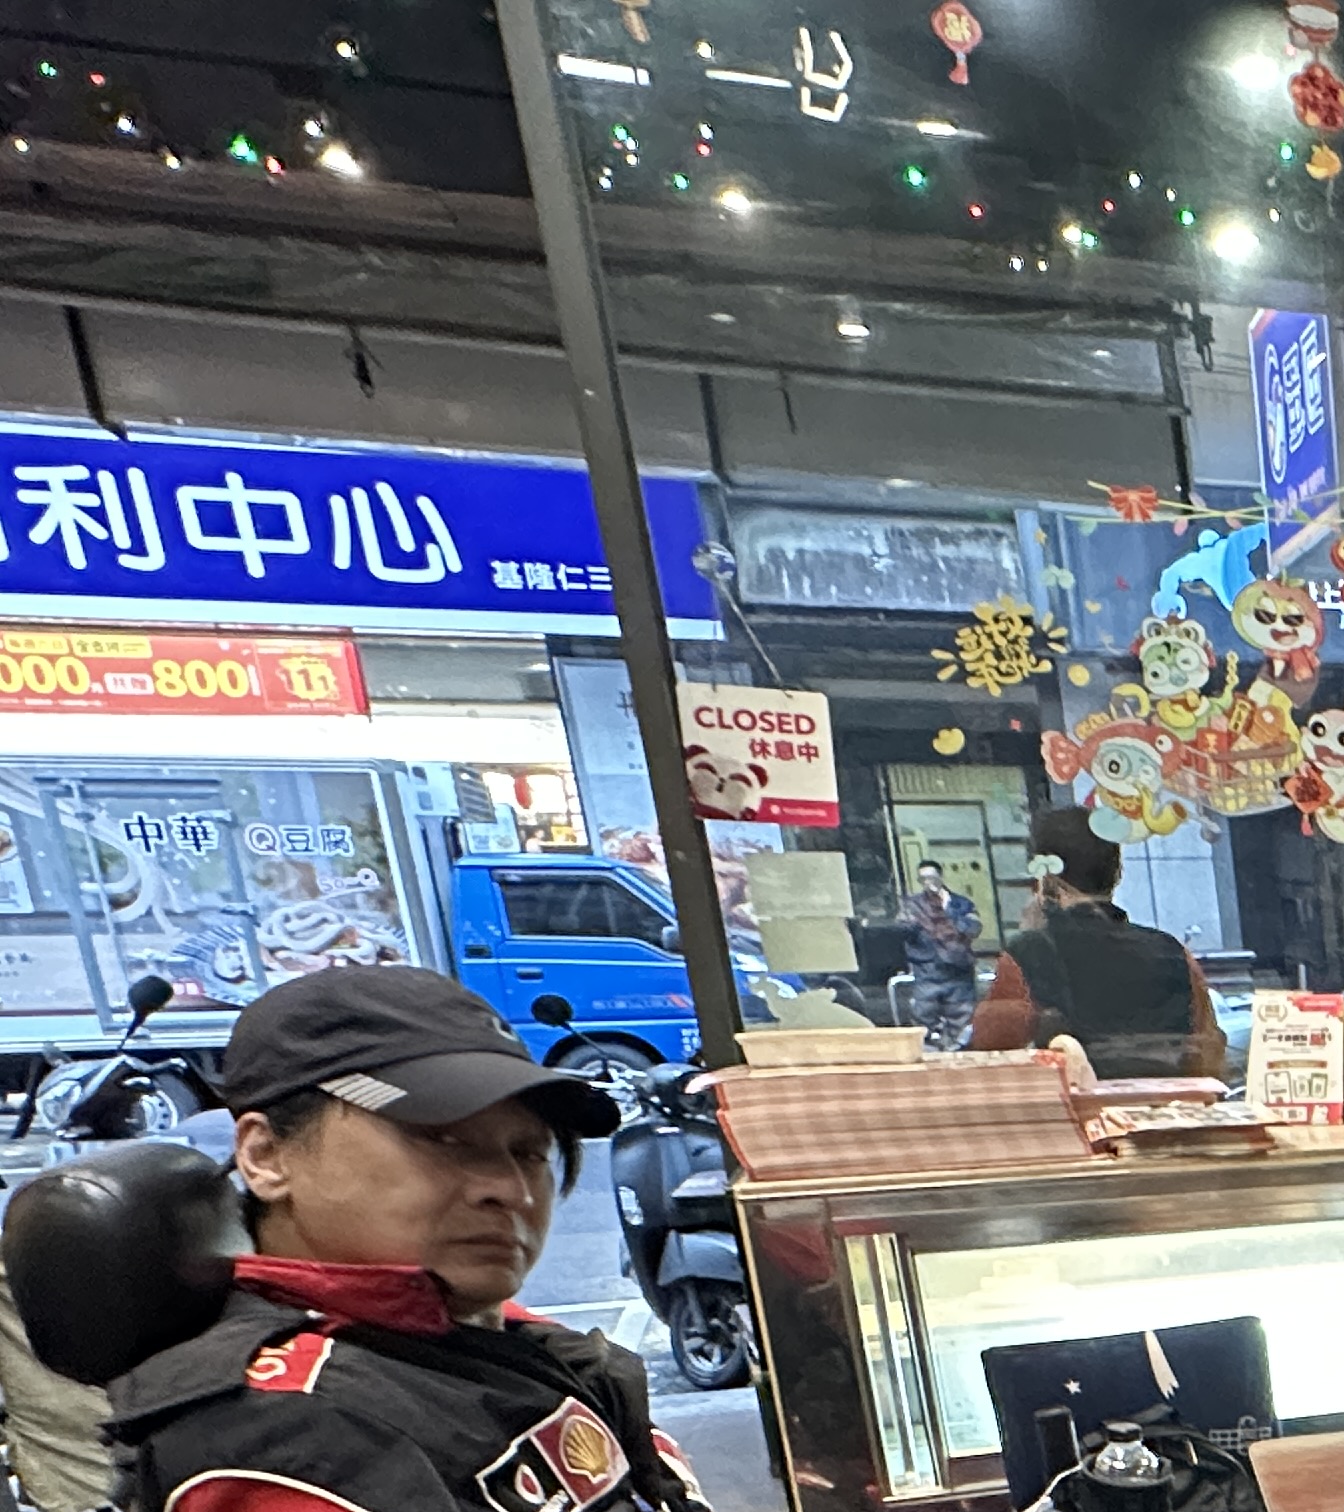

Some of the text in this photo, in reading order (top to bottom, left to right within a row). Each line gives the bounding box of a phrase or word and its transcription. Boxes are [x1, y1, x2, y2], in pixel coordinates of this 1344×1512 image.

[0, 464, 463, 584] 利中心
[152, 659, 250, 698] 800
[693, 706, 817, 735] CLOSED
[748, 739, 820, 763] 休息中
[121, 812, 354, 857] 中華 Q豆腐
